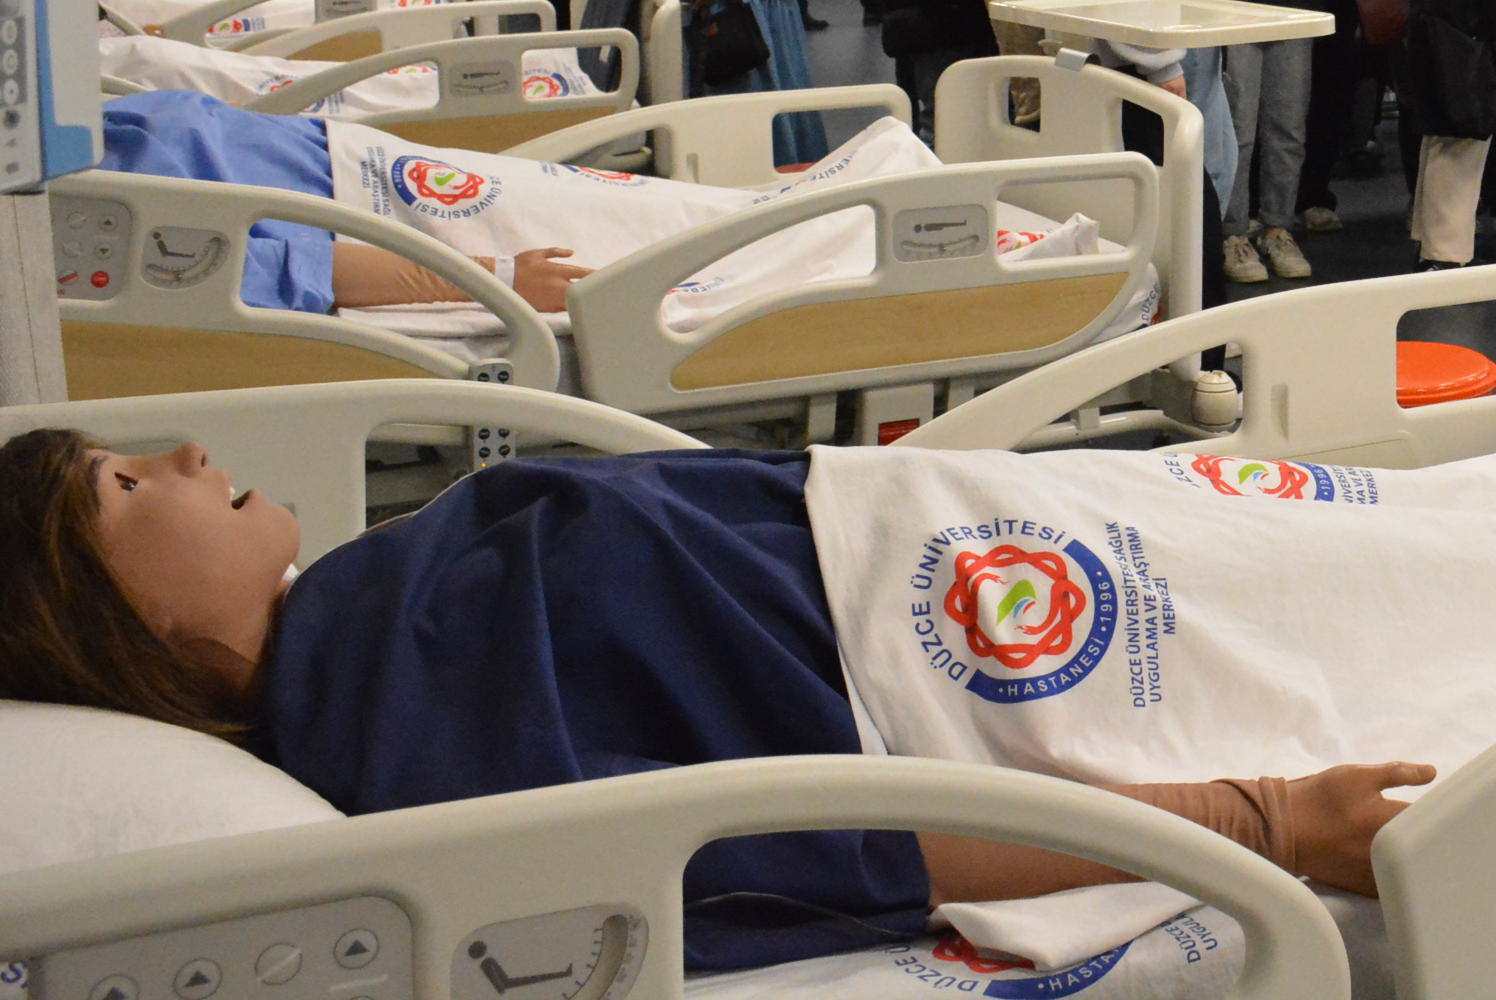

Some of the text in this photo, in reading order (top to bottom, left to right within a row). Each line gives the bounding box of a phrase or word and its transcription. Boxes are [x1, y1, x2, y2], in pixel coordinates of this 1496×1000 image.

[909, 517, 1066, 682] DÜZCE ÜNİVERSİTESİ
[1144, 594, 1158, 613] VE
[1007, 580, 1112, 697] HASTANESİ 1996
[1145, 616, 1162, 703] UYGULAMA
[1129, 658, 1146, 708] DÜZCE
[894, 956, 979, 992] DÜZCE
[1048, 950, 1117, 992] HASTA
